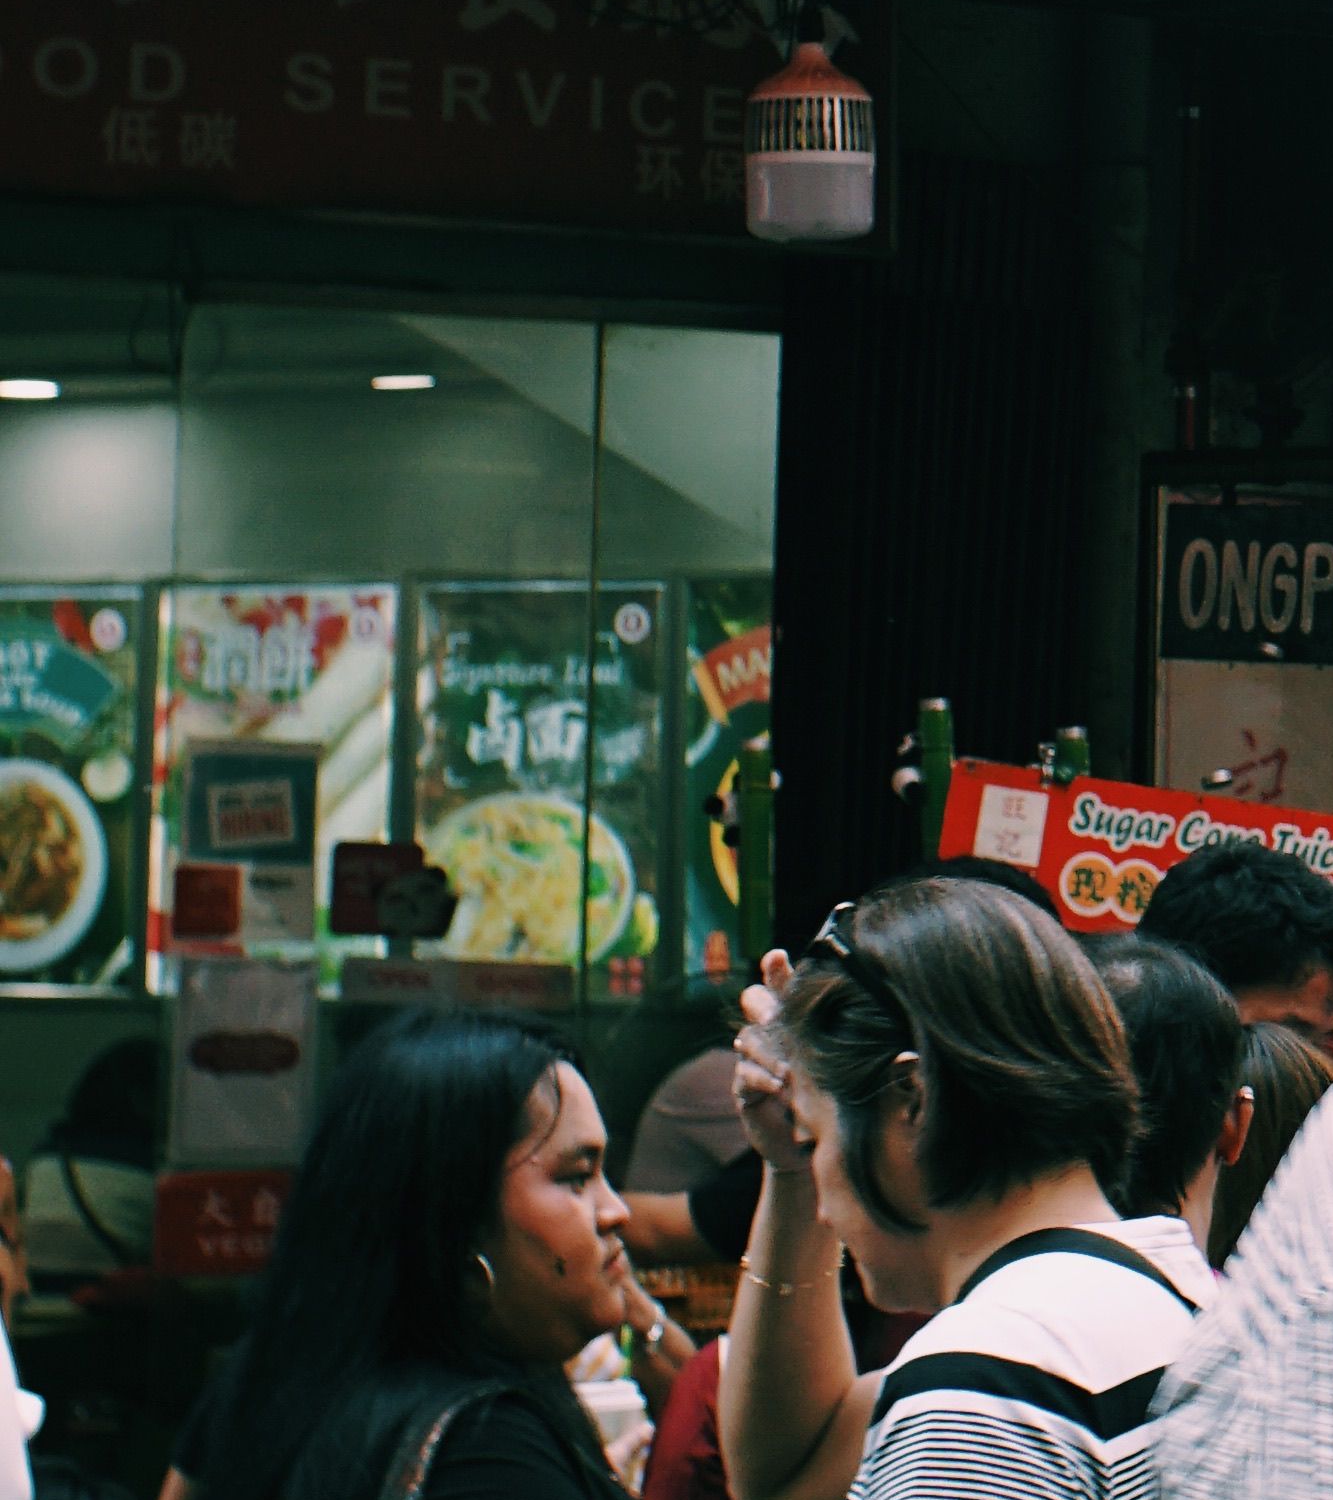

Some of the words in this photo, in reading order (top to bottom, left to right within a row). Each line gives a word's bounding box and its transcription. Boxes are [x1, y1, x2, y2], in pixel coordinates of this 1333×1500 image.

[0, 36, 187, 105] OD
[284, 48, 746, 147] SERVICE
[1070, 795, 1172, 850] Sugar
